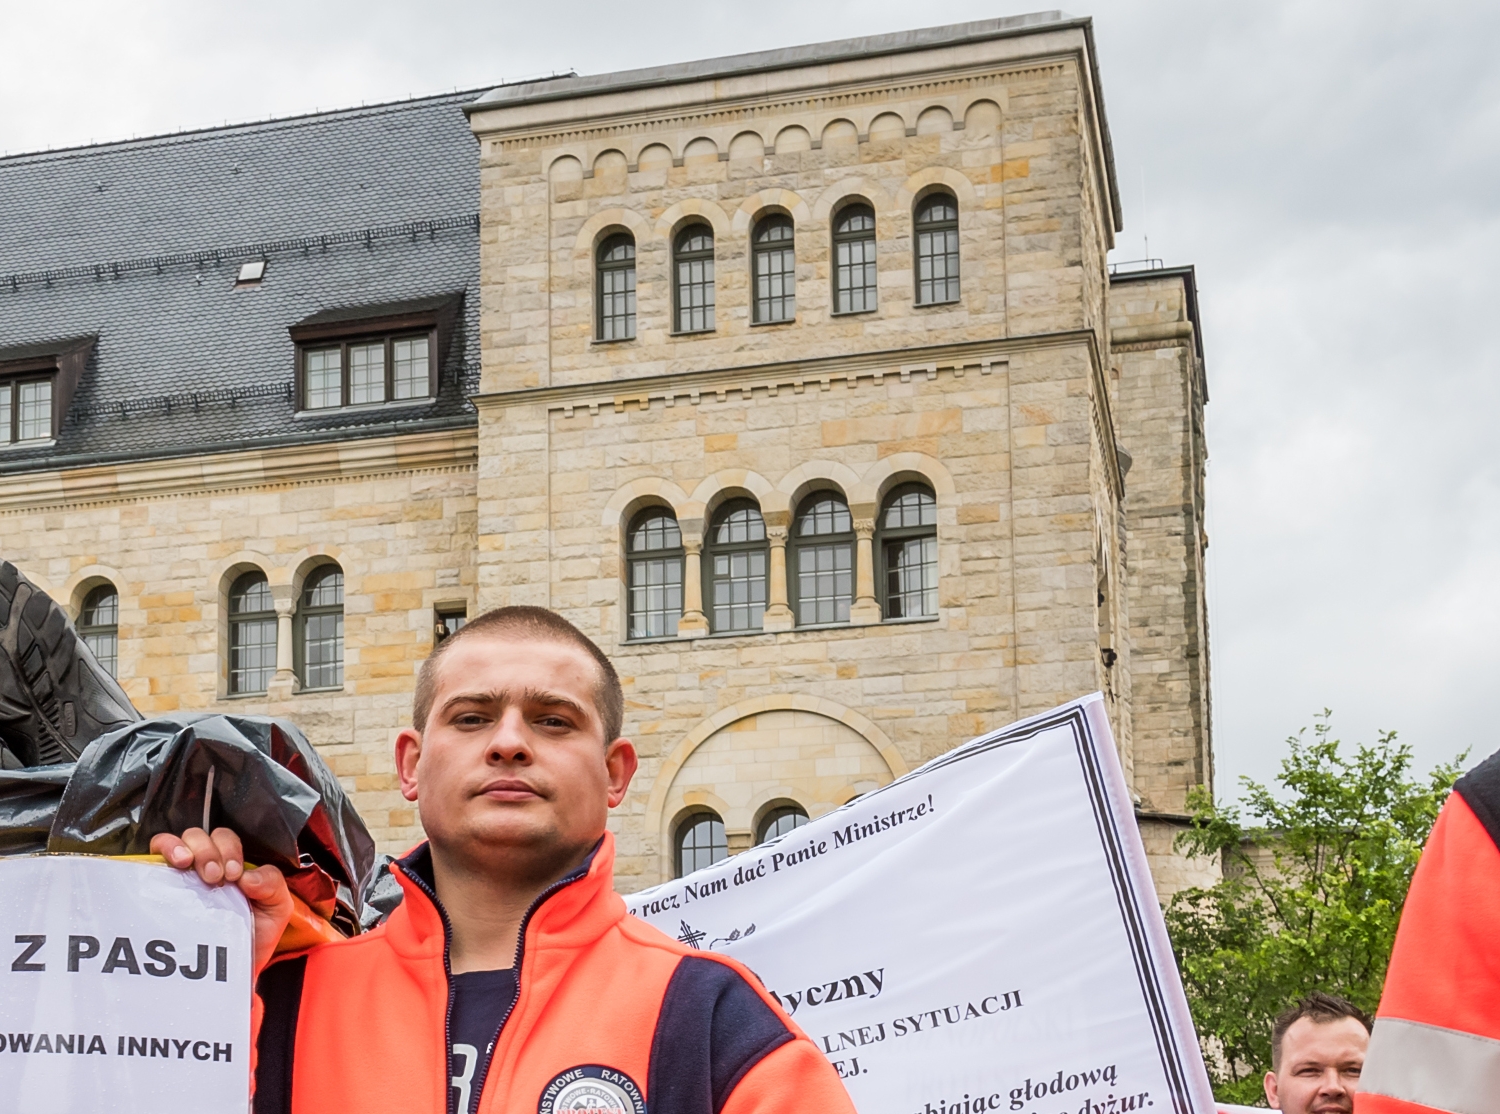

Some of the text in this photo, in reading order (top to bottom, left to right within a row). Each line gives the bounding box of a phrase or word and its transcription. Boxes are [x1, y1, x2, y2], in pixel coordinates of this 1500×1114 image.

[642, 794, 936, 918] racz Nam dać Panie Ministrze!
[11, 934, 47, 973] Z
[67, 934, 229, 982] PASJI
[811, 989, 1025, 1056] LNEJ SYTUACJI
[117, 1035, 233, 1063] INNYCH
[1008, 1064, 1119, 1111] głodową
